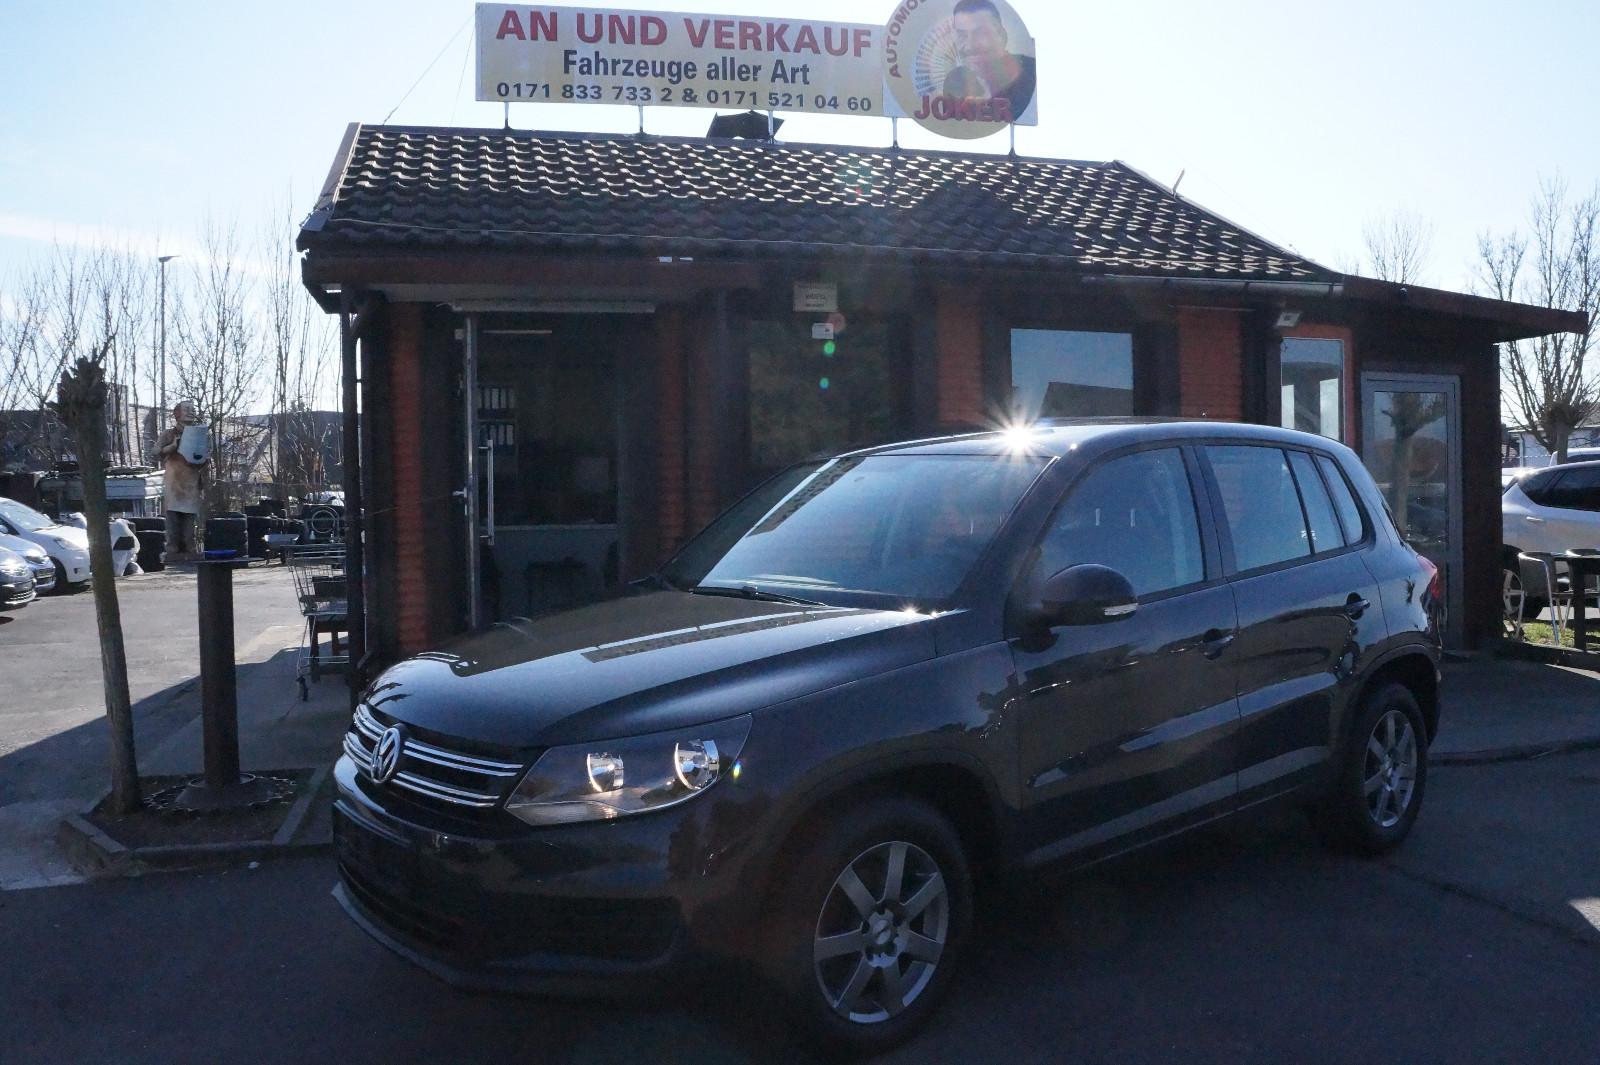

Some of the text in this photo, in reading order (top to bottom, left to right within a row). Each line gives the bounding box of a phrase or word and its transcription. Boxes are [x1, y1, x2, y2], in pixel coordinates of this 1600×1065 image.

[496, 10, 872, 57] AN UND VERKAUF
[886, 0, 926, 78] AUTOMO
[563, 49, 810, 85] Fahrzeuge aller Art
[496, 82, 872, 111] 0171 833 733 2 & 0171 521 04 60
[913, 95, 1014, 123] JOKER
